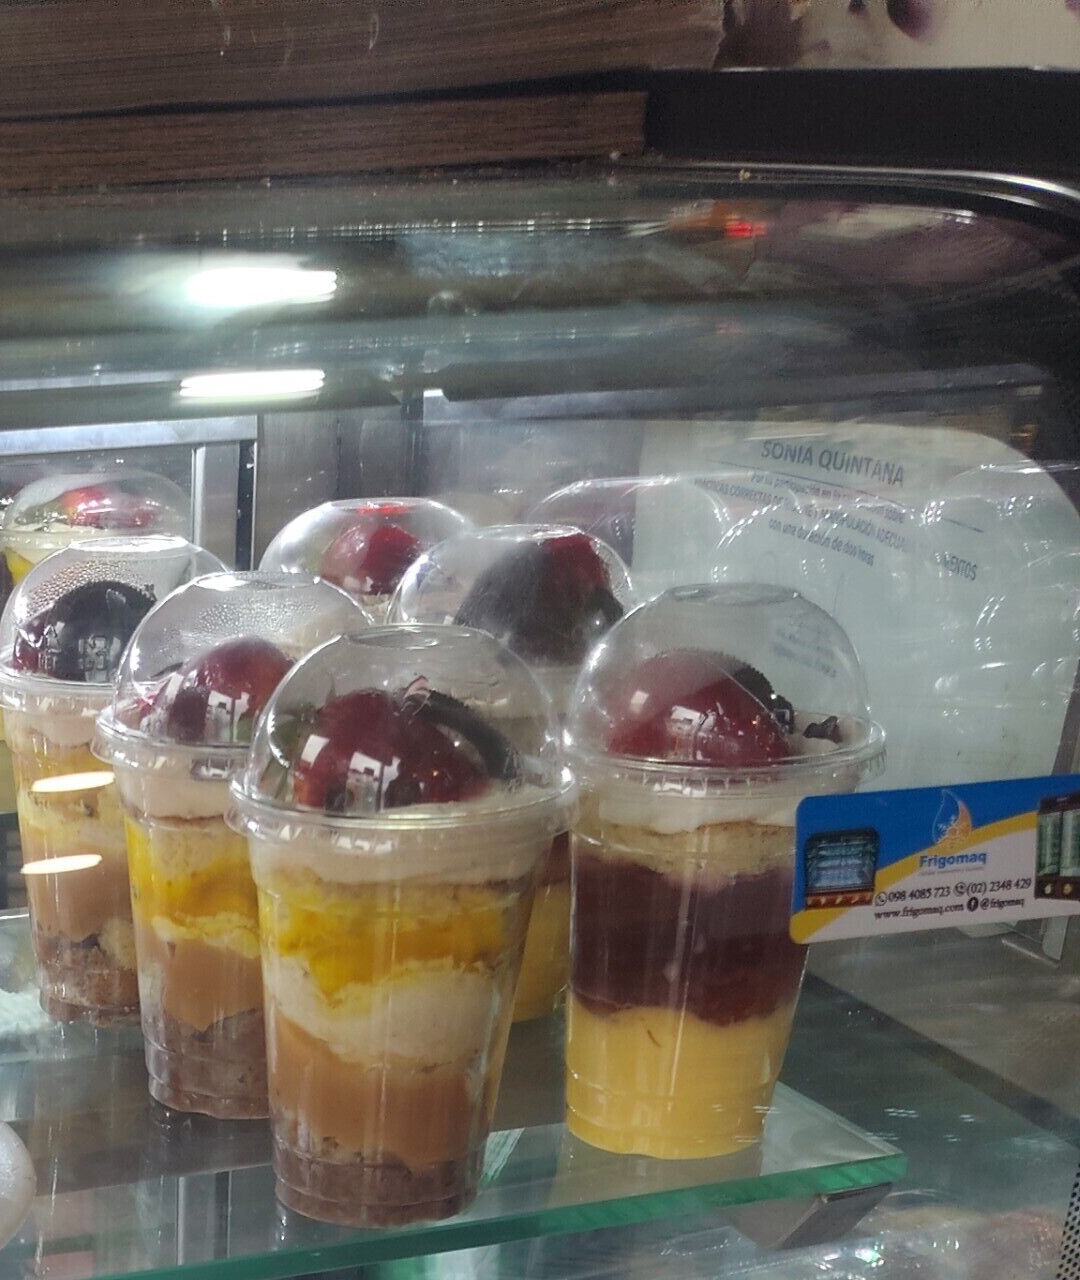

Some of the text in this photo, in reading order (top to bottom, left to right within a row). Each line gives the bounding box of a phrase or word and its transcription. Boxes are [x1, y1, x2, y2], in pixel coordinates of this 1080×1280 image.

[761, 440, 904, 487] SONIA QUINTANA
[919, 853, 987, 869] Frigomaq
[934, 886, 952, 898] 723
[966, 882, 988, 896] (02)
[989, 879, 1012, 892] 2348
